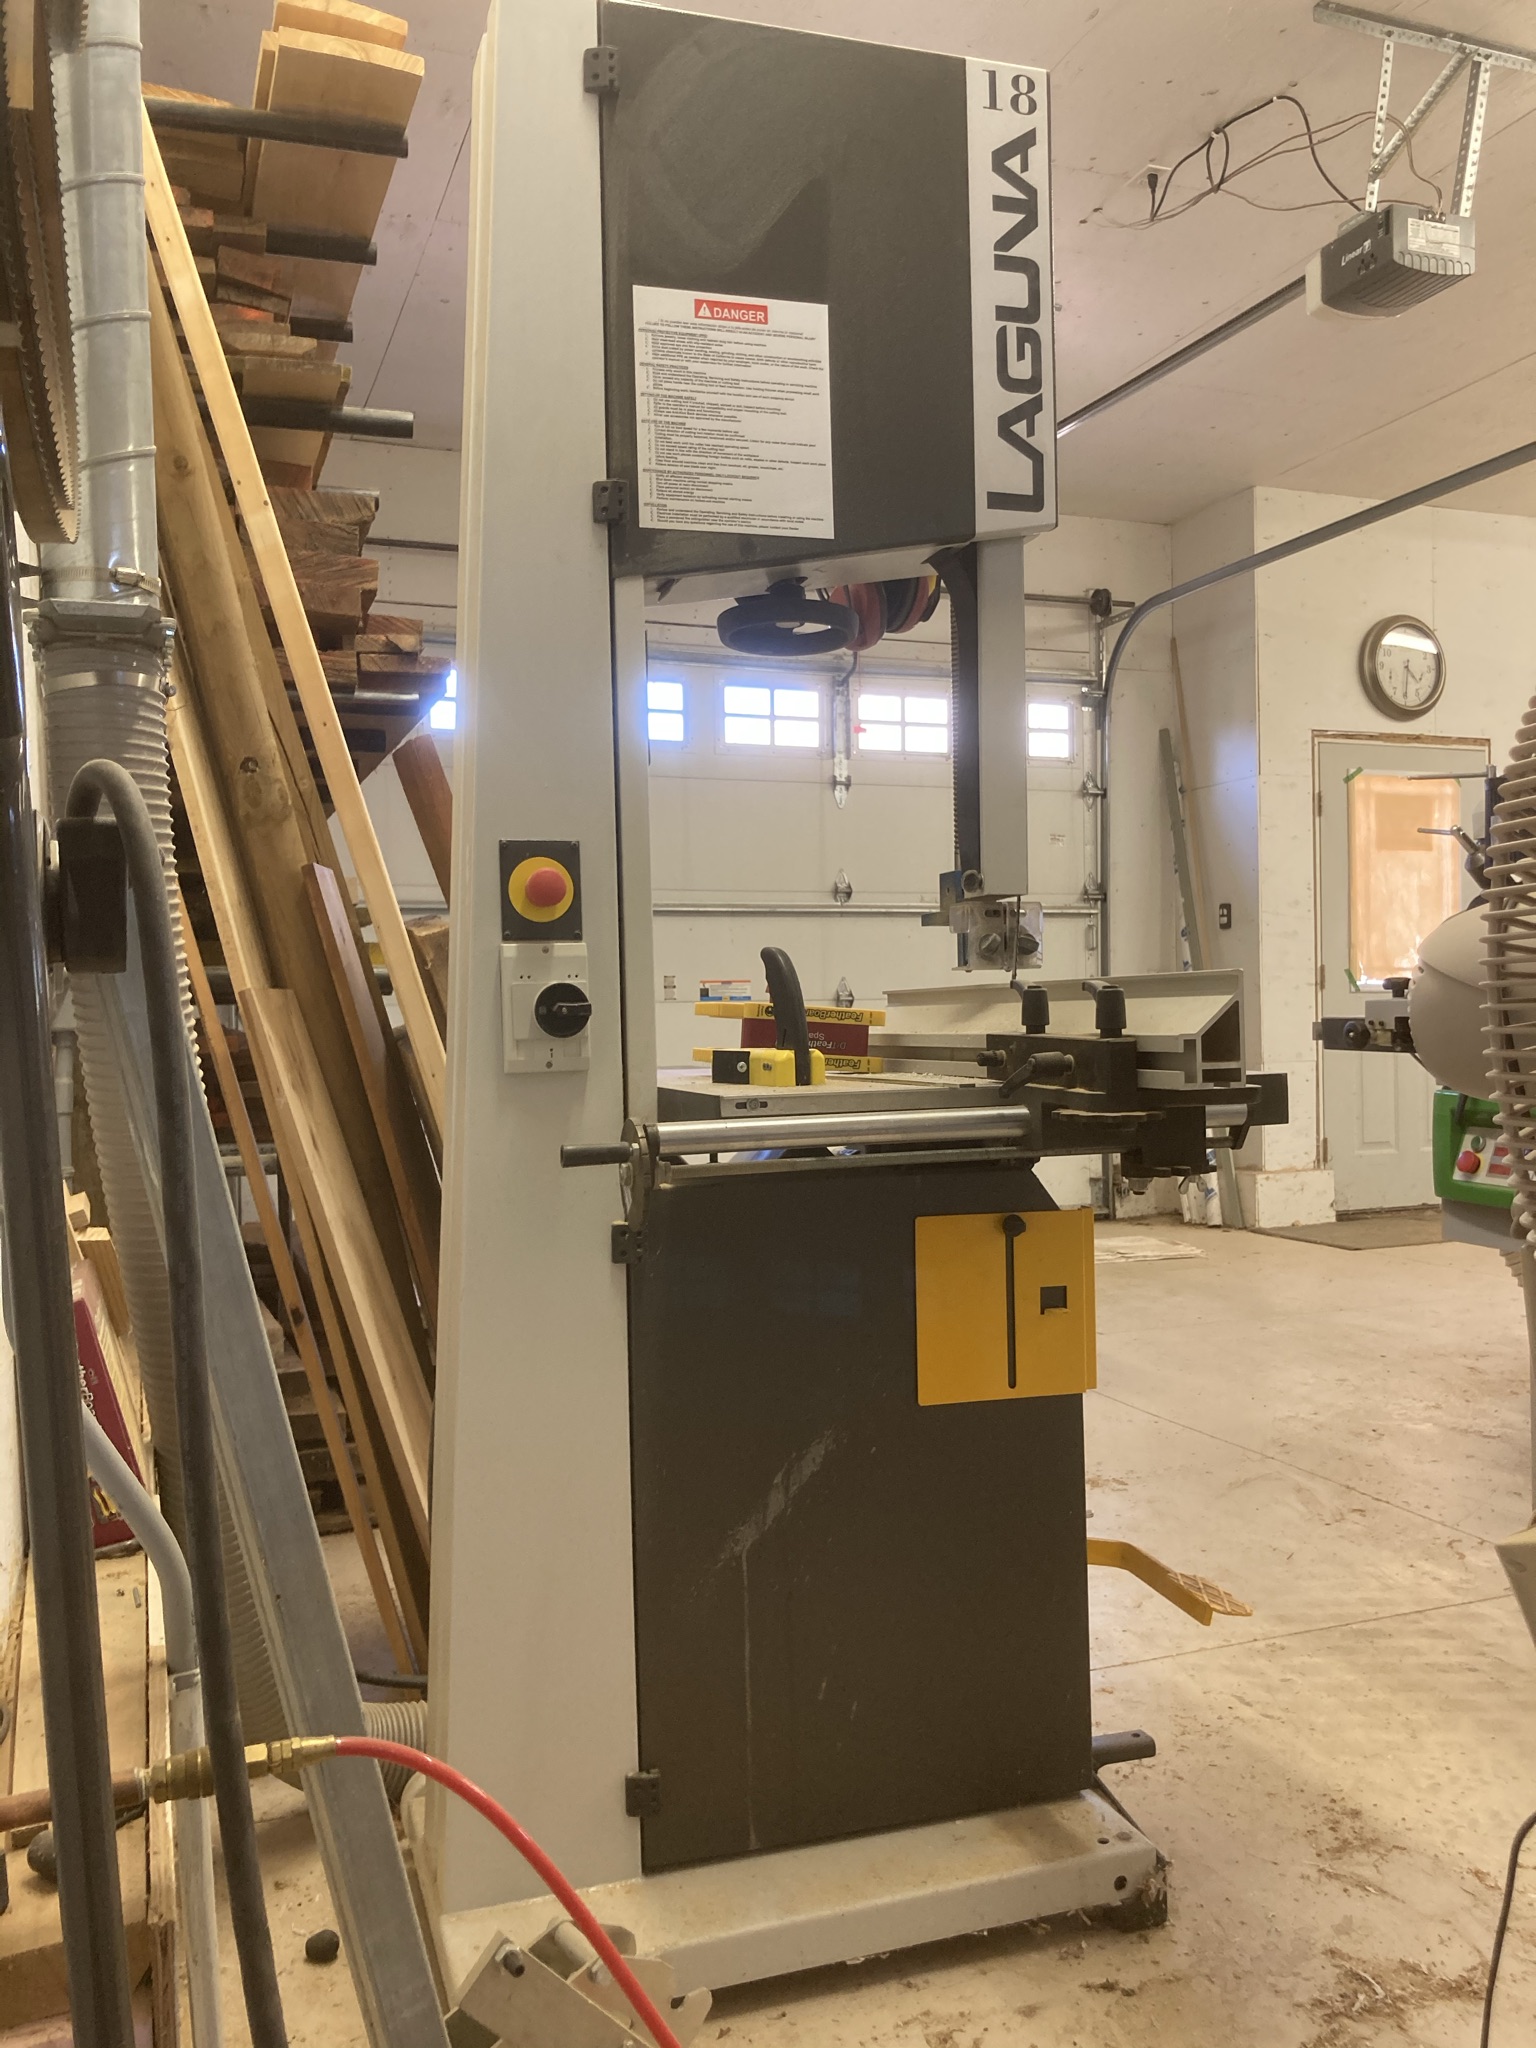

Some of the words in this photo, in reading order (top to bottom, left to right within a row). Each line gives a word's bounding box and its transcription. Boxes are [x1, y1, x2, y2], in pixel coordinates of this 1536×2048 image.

[981, 69, 1038, 116] 18
[713, 307, 765, 323] DANGER
[986, 126, 1044, 513] LAGUNA
[805, 1010, 863, 1023] FeatherBoar
[808, 1031, 825, 1040] Spa
[825, 1058, 861, 1070] Feather
